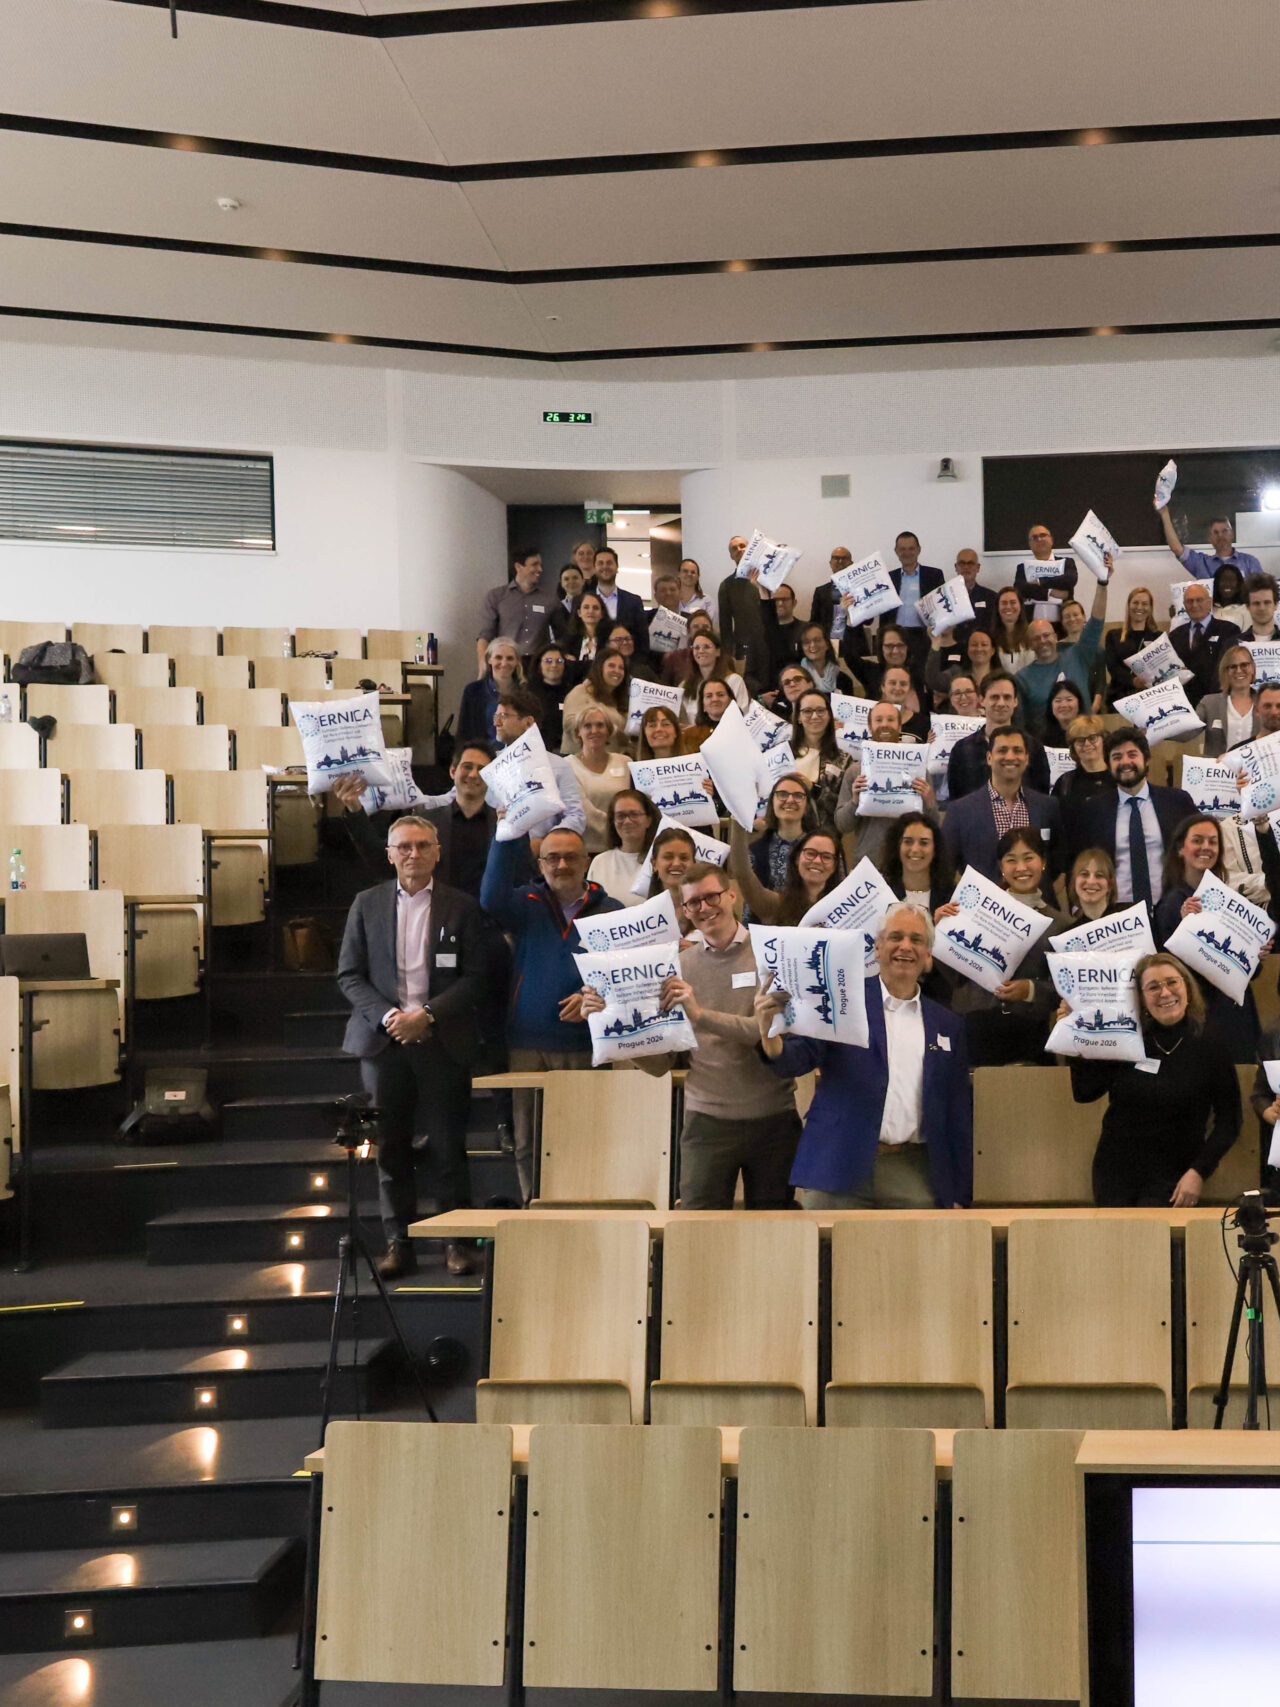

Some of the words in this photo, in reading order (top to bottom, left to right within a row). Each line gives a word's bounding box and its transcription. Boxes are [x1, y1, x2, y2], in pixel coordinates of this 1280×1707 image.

[569, 414, 575, 422] 3
[847, 559, 881, 581] ERNICA
[1142, 642, 1171, 663] ERNICA
[643, 686, 678, 701] ERNICA
[1139, 684, 1179, 700] ERNICA
[319, 709, 373, 727] ERNICA
[876, 750, 923, 762] ERNICA
[656, 762, 702, 776] ERNICA
[1206, 768, 1237, 779] ERNI
[827, 880, 877, 924] ERNICA
[981, 896, 1031, 936] ERNICA
[1227, 899, 1270, 941] ERNICA
[610, 914, 668, 940] ERNICA
[1086, 917, 1144, 945] ERNICA
[949, 947, 968, 962] Prague
[969, 959, 983, 972] 2026
[1198, 947, 1218, 964] Prague
[1218, 962, 1230, 975] 2026
[611, 963, 677, 984] ERNICA
[1078, 968, 1136, 982] ERNICA
[618, 1039, 644, 1049] Prague
[647, 1034, 663, 1044] 2026
[1074, 1036, 1099, 1046] Prague
